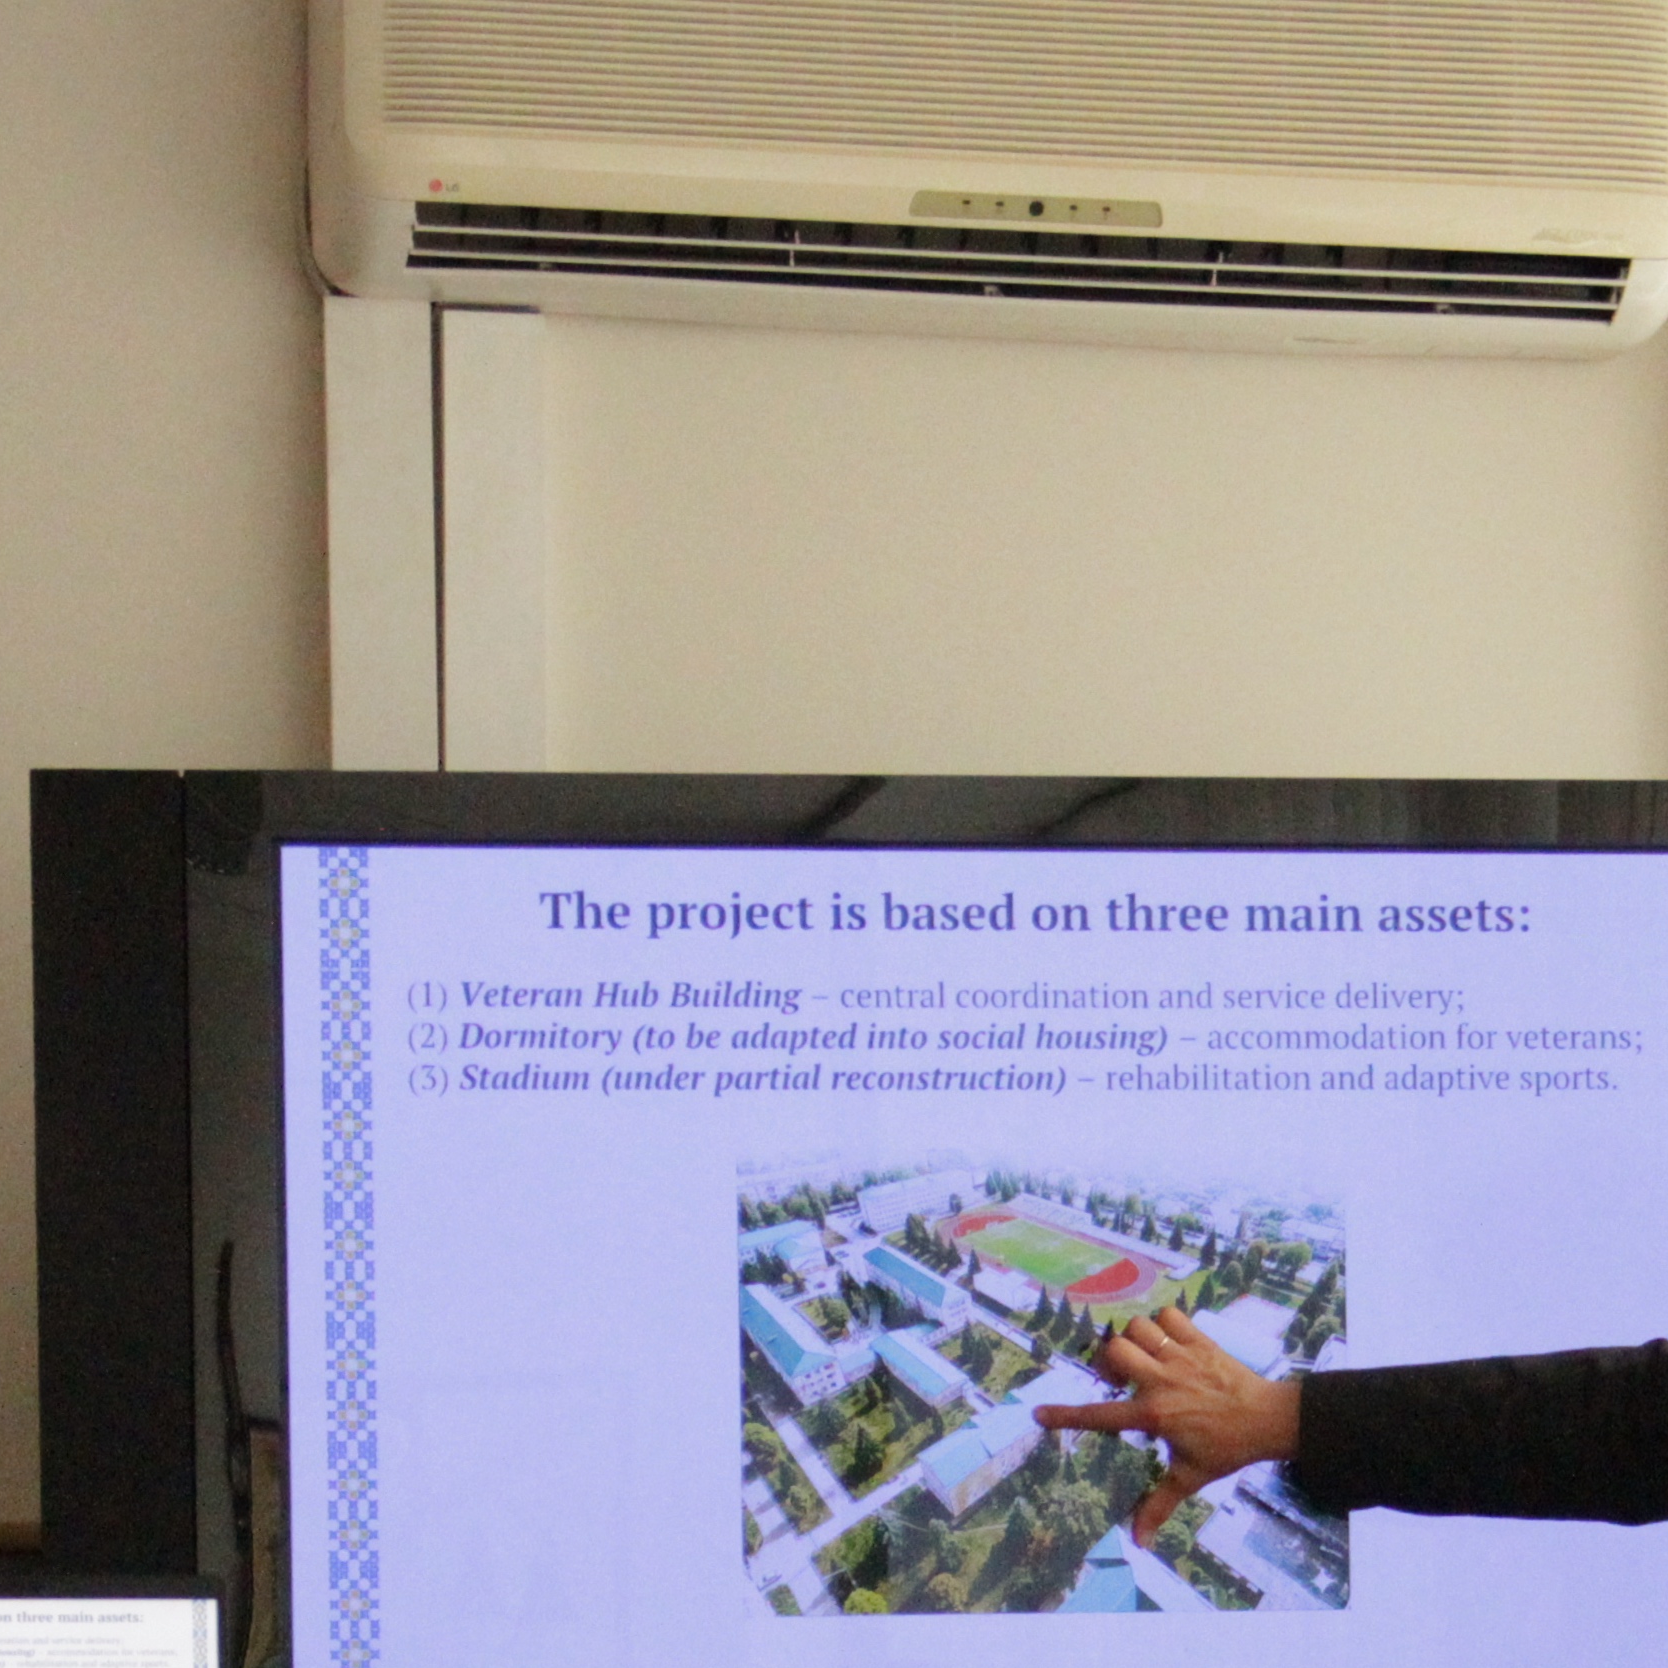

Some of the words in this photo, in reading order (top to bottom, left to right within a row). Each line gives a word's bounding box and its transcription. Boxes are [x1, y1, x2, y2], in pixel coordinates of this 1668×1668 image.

[538, 890, 632, 930] The
[647, 891, 815, 940] project
[830, 891, 868, 931] is
[881, 891, 1017, 932] based
[1030, 904, 1092, 932] on
[1105, 892, 1230, 932] three
[1244, 894, 1364, 932] main
[1377, 900, 1531, 933] assets:
[406, 981, 449, 1012] (1)
[460, 980, 585, 1008] Veteran
[592, 979, 661, 1009] Hub
[668, 979, 804, 1016] Building
[838, 980, 947, 1009] central
[954, 981, 1150, 1009] coordination
[1157, 981, 1214, 1010] and
[1222, 982, 1327, 1009] service
[1333, 981, 1465, 1016] delivery;
[407, 1023, 450, 1053] (2)
[457, 1022, 624, 1056] Dormitory
[631, 1024, 678, 1055] (to
[684, 1021, 723, 1050] be
[729, 1021, 860, 1056] adapted
[865, 1022, 930, 1050] into
[936, 1022, 1028, 1051] social
[1034, 1022, 1170, 1057] housing)
[1206, 1022, 1447, 1050] accommodation
[1455, 1022, 1499, 1050] for
[1504, 1027, 1644, 1054] veterans;
[407, 1063, 450, 1096] (3)
[458, 1062, 592, 1091] Stadium
[600, 1062, 707, 1097] (under
[712, 1062, 823, 1098] partial
[830, 1063, 1068, 1096] reconstruction)
[1105, 1063, 1312, 1091] rehabilitation
[1319, 1063, 1376, 1091] and
[1383, 1063, 1511, 1098] adaptive
[1518, 1068, 1619, 1097] sports.
[17, 1611, 53, 1622] three
[58, 1612, 94, 1623] main
[98, 1613, 144, 1623] assets:
